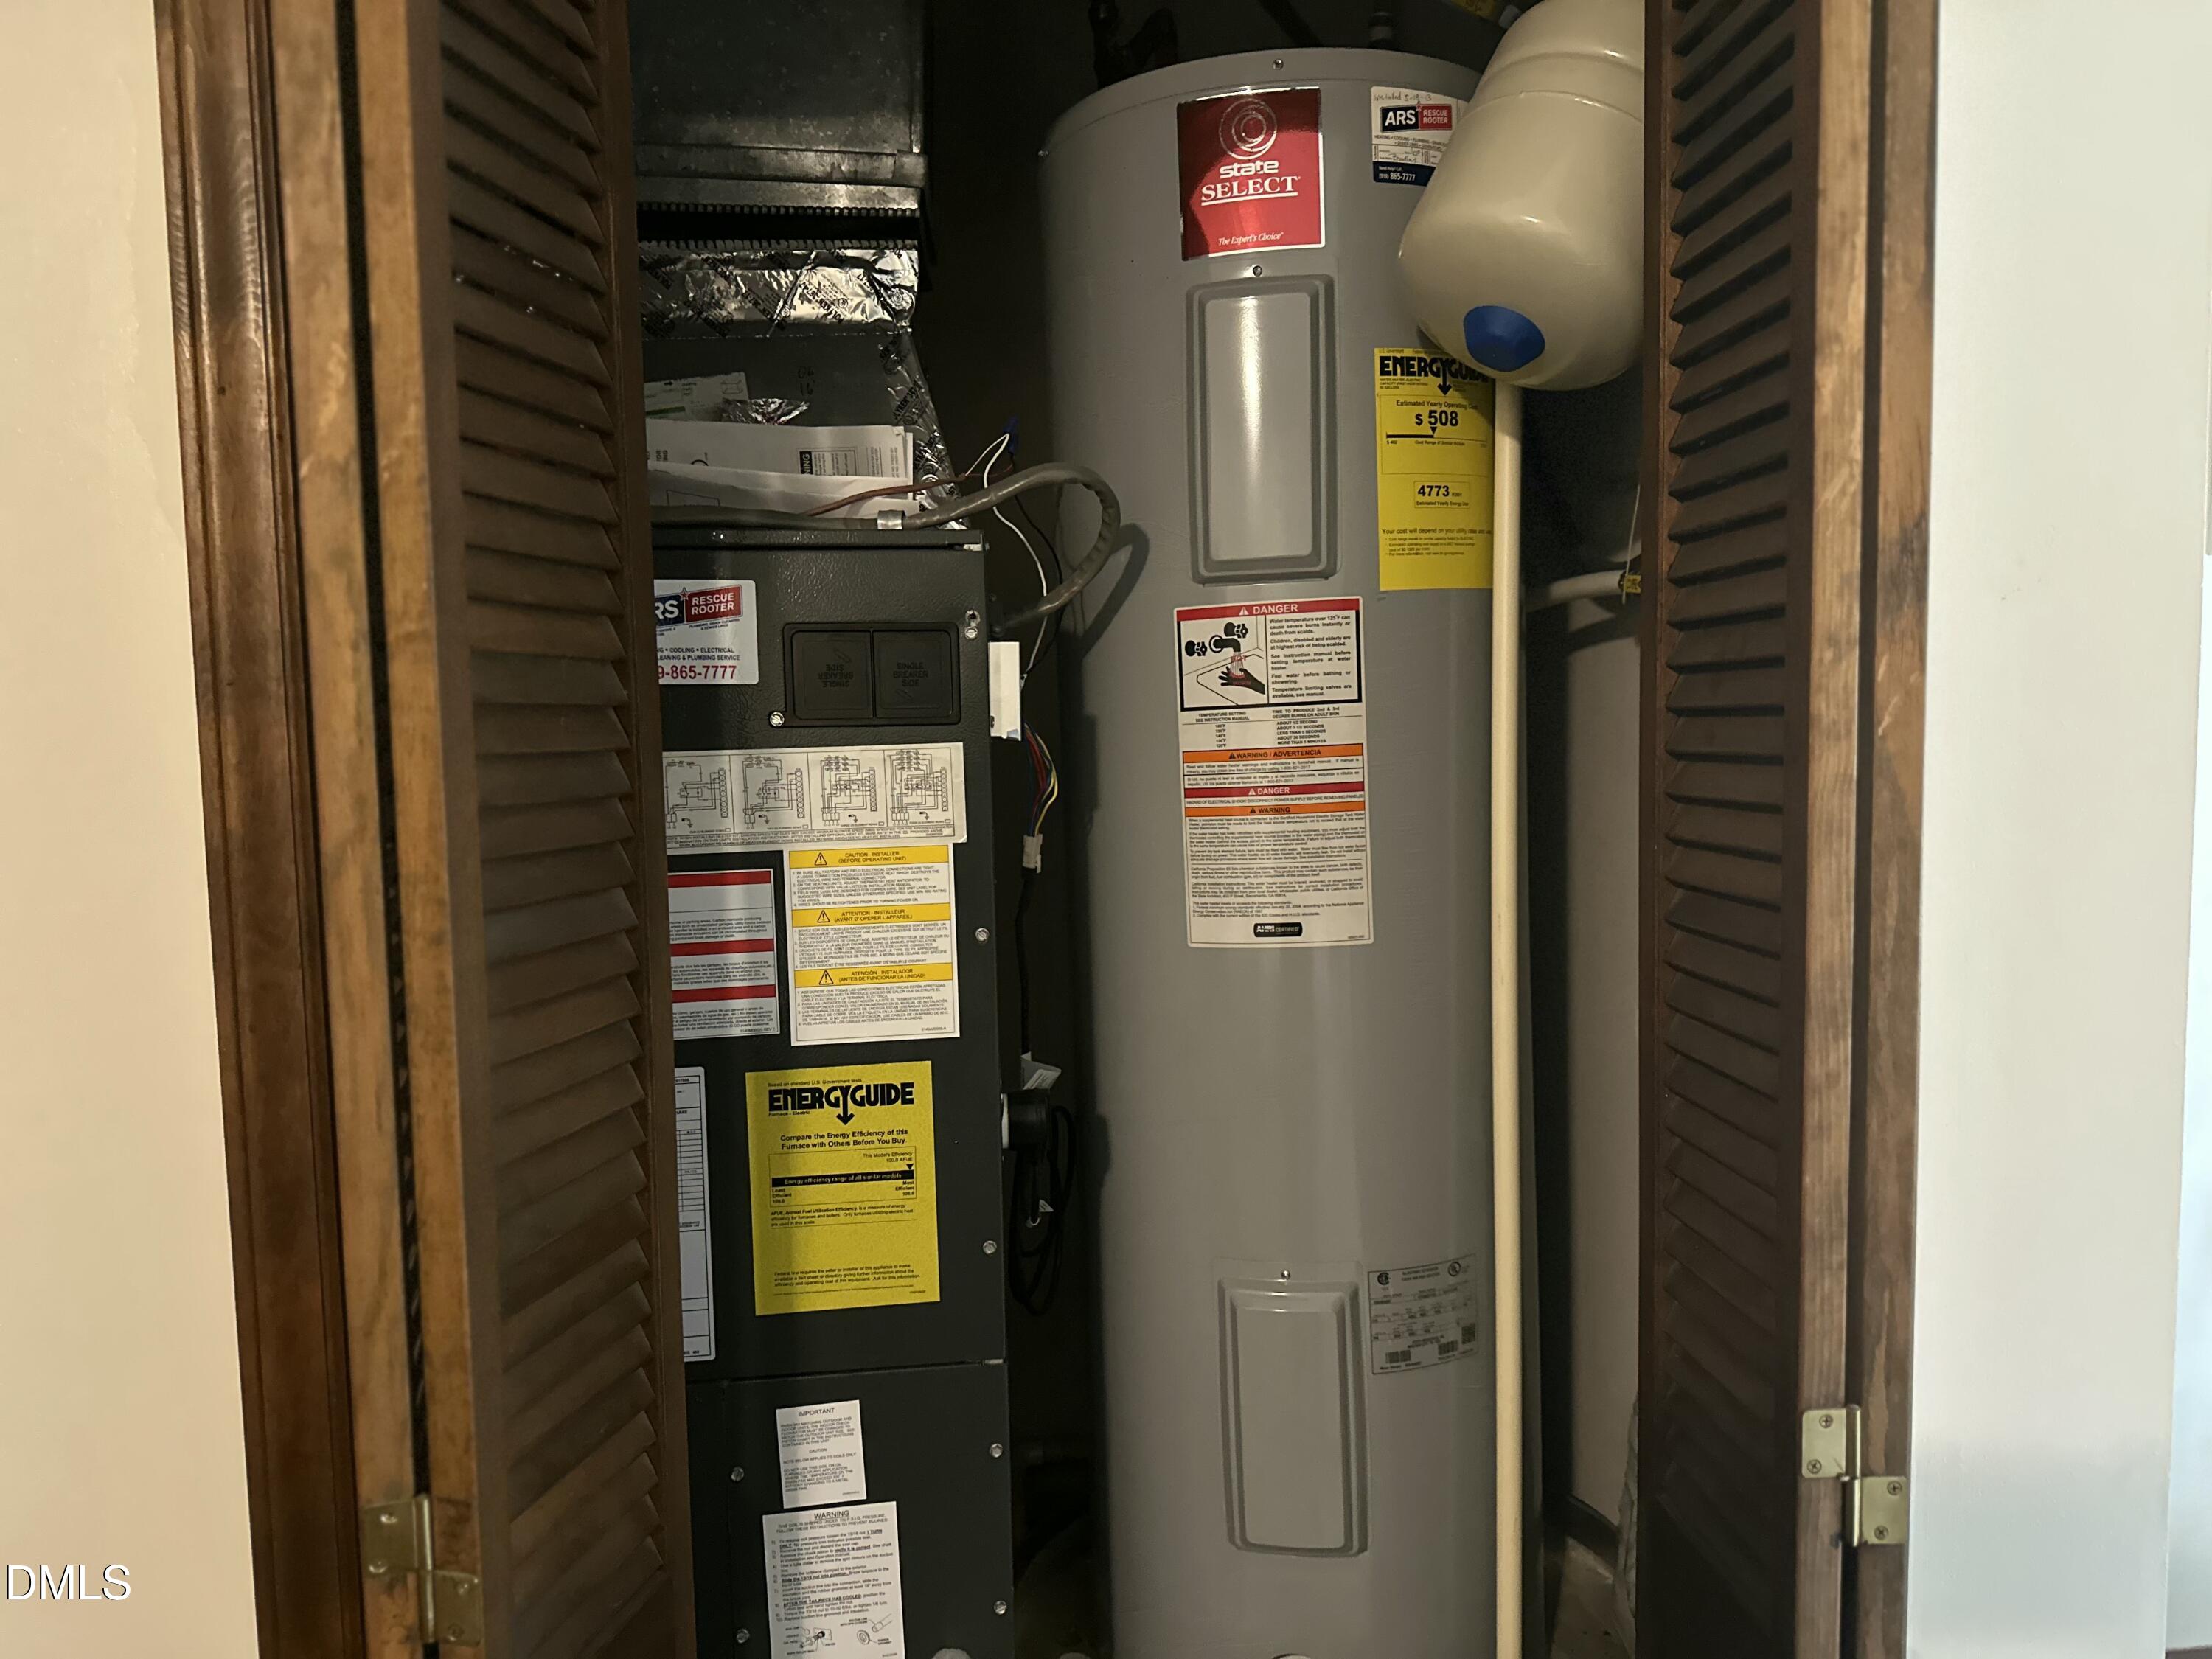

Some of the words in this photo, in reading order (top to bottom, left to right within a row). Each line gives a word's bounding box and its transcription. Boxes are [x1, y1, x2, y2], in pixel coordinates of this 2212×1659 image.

[1385, 110, 1415, 126] ARS
[1220, 160, 1279, 178] state
[1390, 173, 1415, 181] 865-7777
[1201, 175, 1298, 201] SELECT
[1231, 234, 1256, 244] Expert's
[1259, 232, 1281, 240] Choice
[1415, 414, 1423, 426] $
[1428, 410, 1458, 426] 508
[1418, 485, 1450, 497] 4773
[692, 593, 734, 605] RESCUE
[692, 602, 734, 615] ROOTER
[1253, 605, 1298, 614] DANGER
[768, 1082, 914, 1111] ENERGYGUIDE
[780, 1133, 812, 1143] Compare
[827, 1132, 849, 1140] Energy
[852, 1130, 885, 1139] Efficiency
[814, 1510, 849, 1519] WARNING
